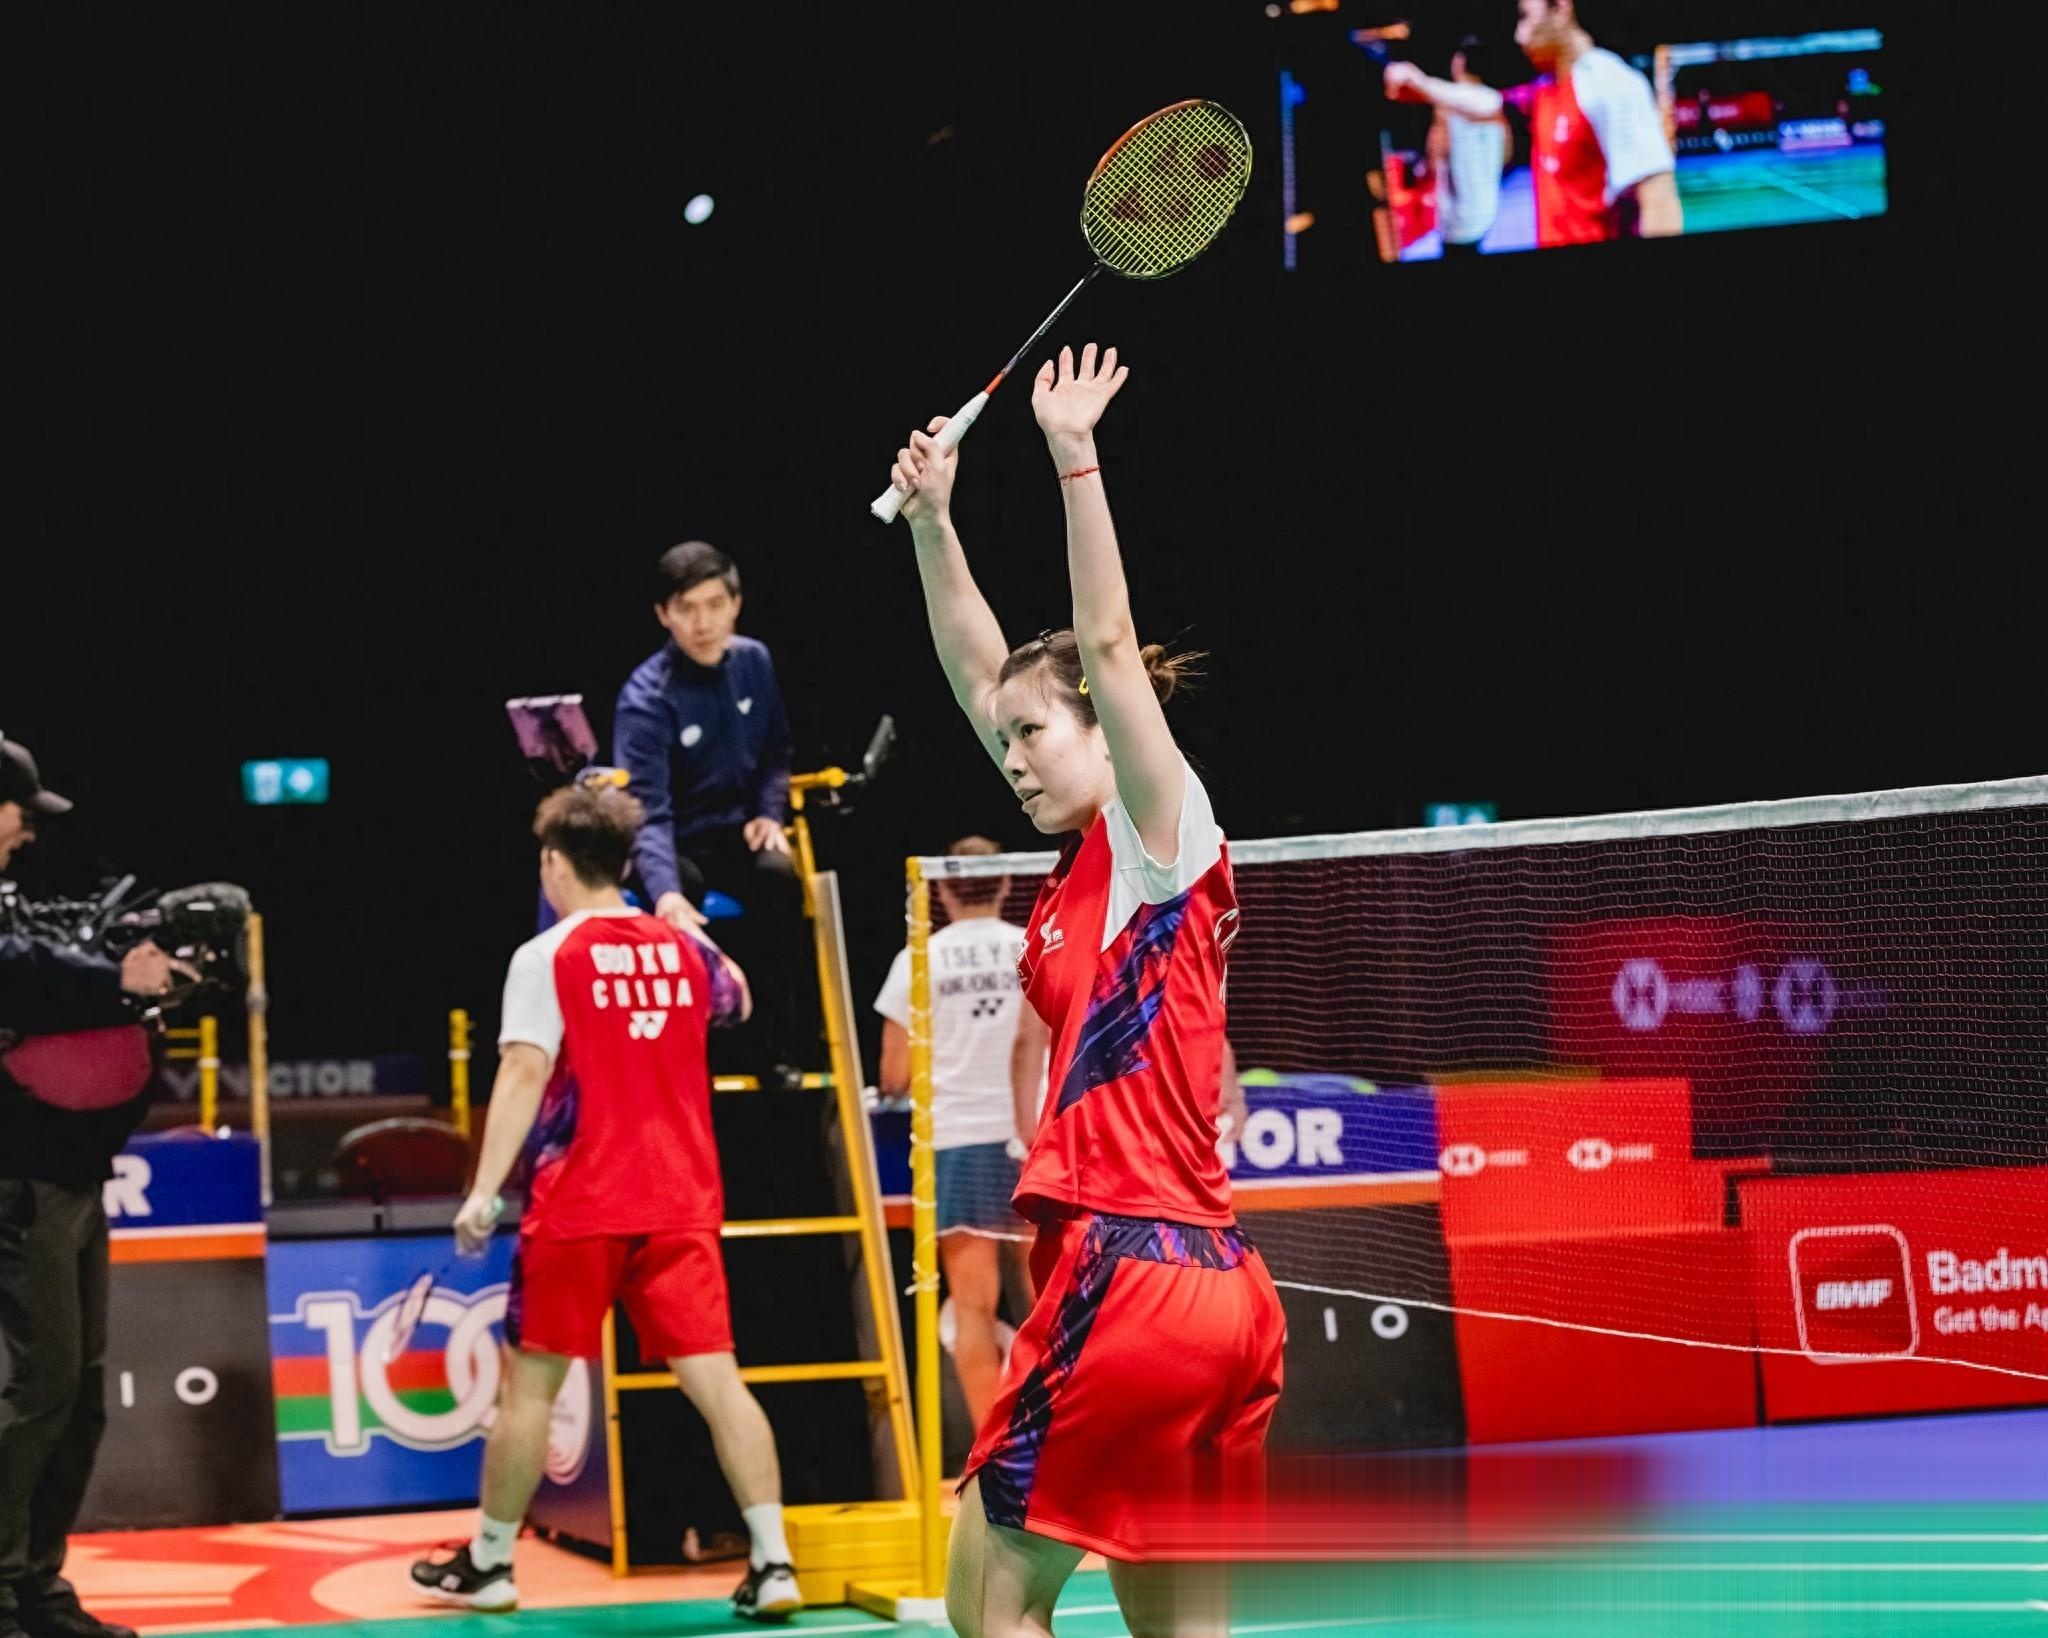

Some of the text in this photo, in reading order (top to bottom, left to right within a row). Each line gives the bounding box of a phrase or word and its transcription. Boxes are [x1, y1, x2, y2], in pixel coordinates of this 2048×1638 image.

[220, 1060, 376, 1097] VCTOR
[1926, 1247, 2048, 1295] Badm
[1933, 1305, 1977, 1335] Get
[1979, 1304, 2019, 1332] the
